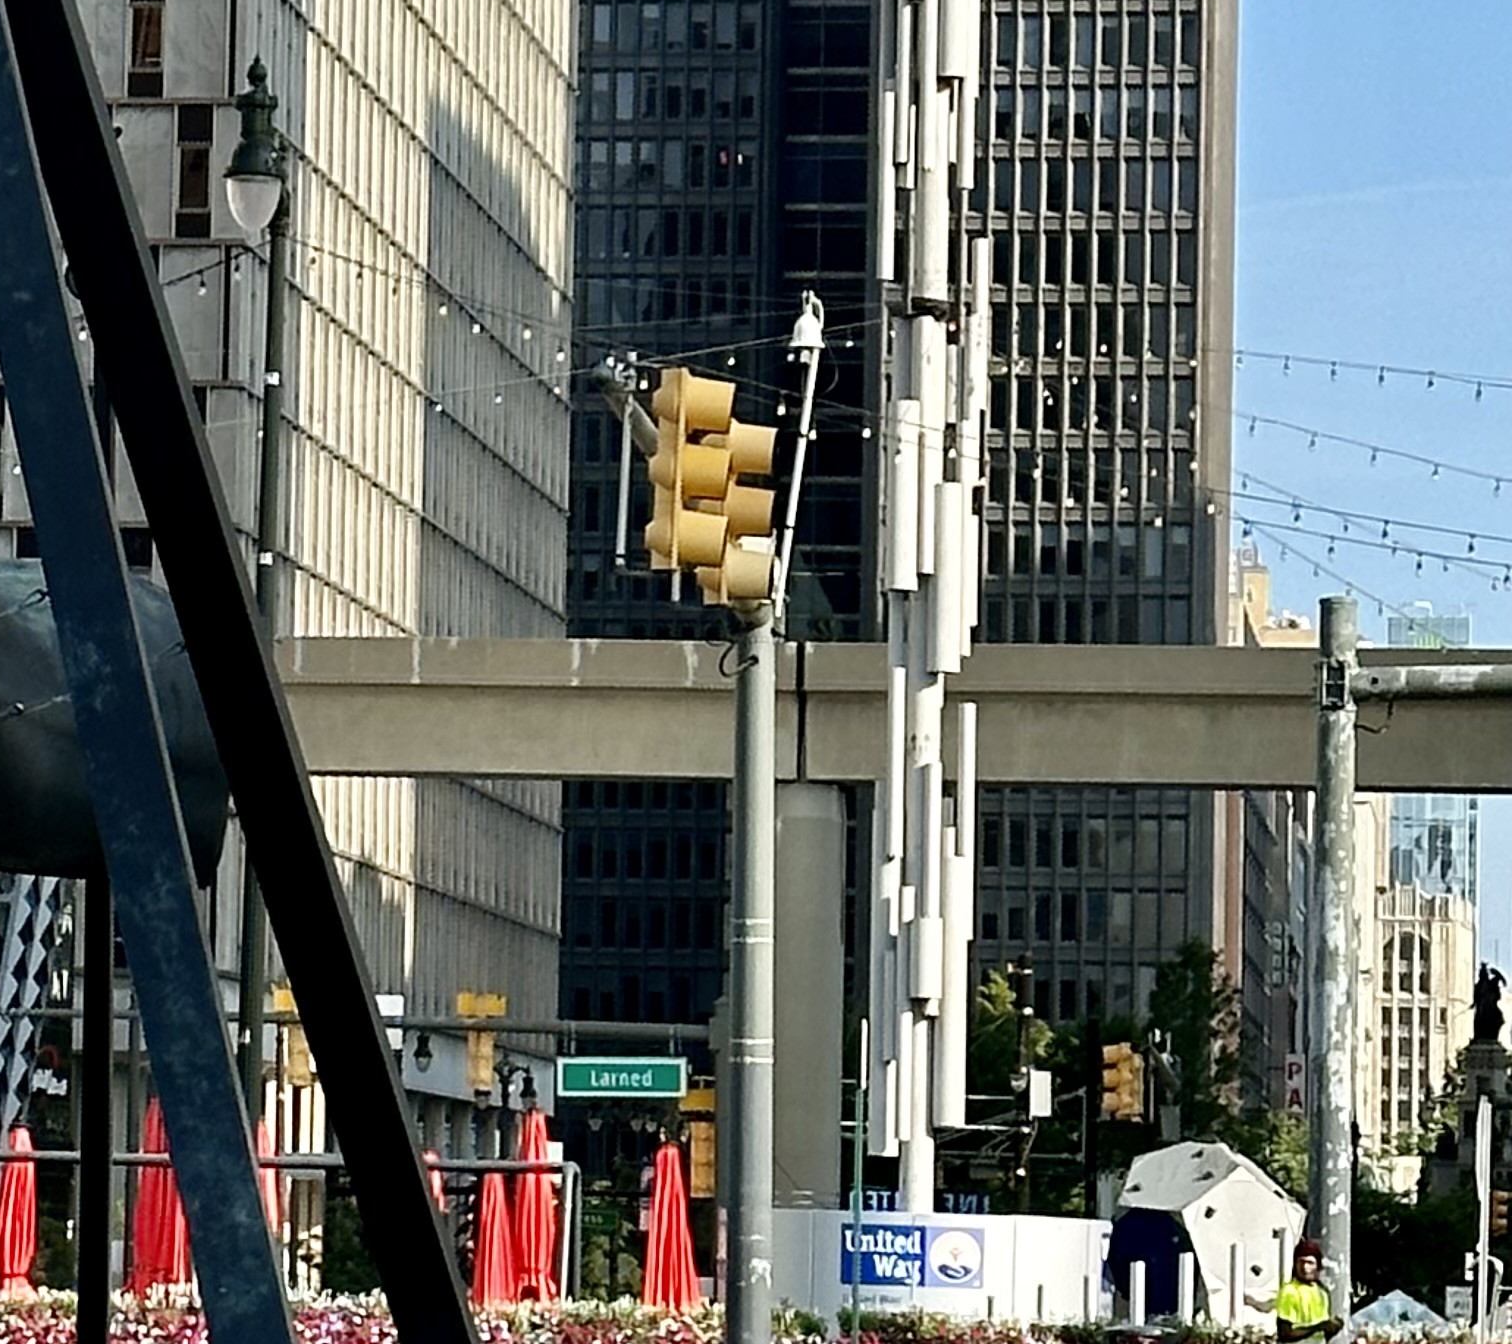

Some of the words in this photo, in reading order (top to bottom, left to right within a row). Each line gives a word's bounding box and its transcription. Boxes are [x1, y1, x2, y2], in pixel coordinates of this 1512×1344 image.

[590, 1069, 653, 1087] Larned
[844, 1229, 921, 1254] United
[872, 1254, 922, 1285] Way
